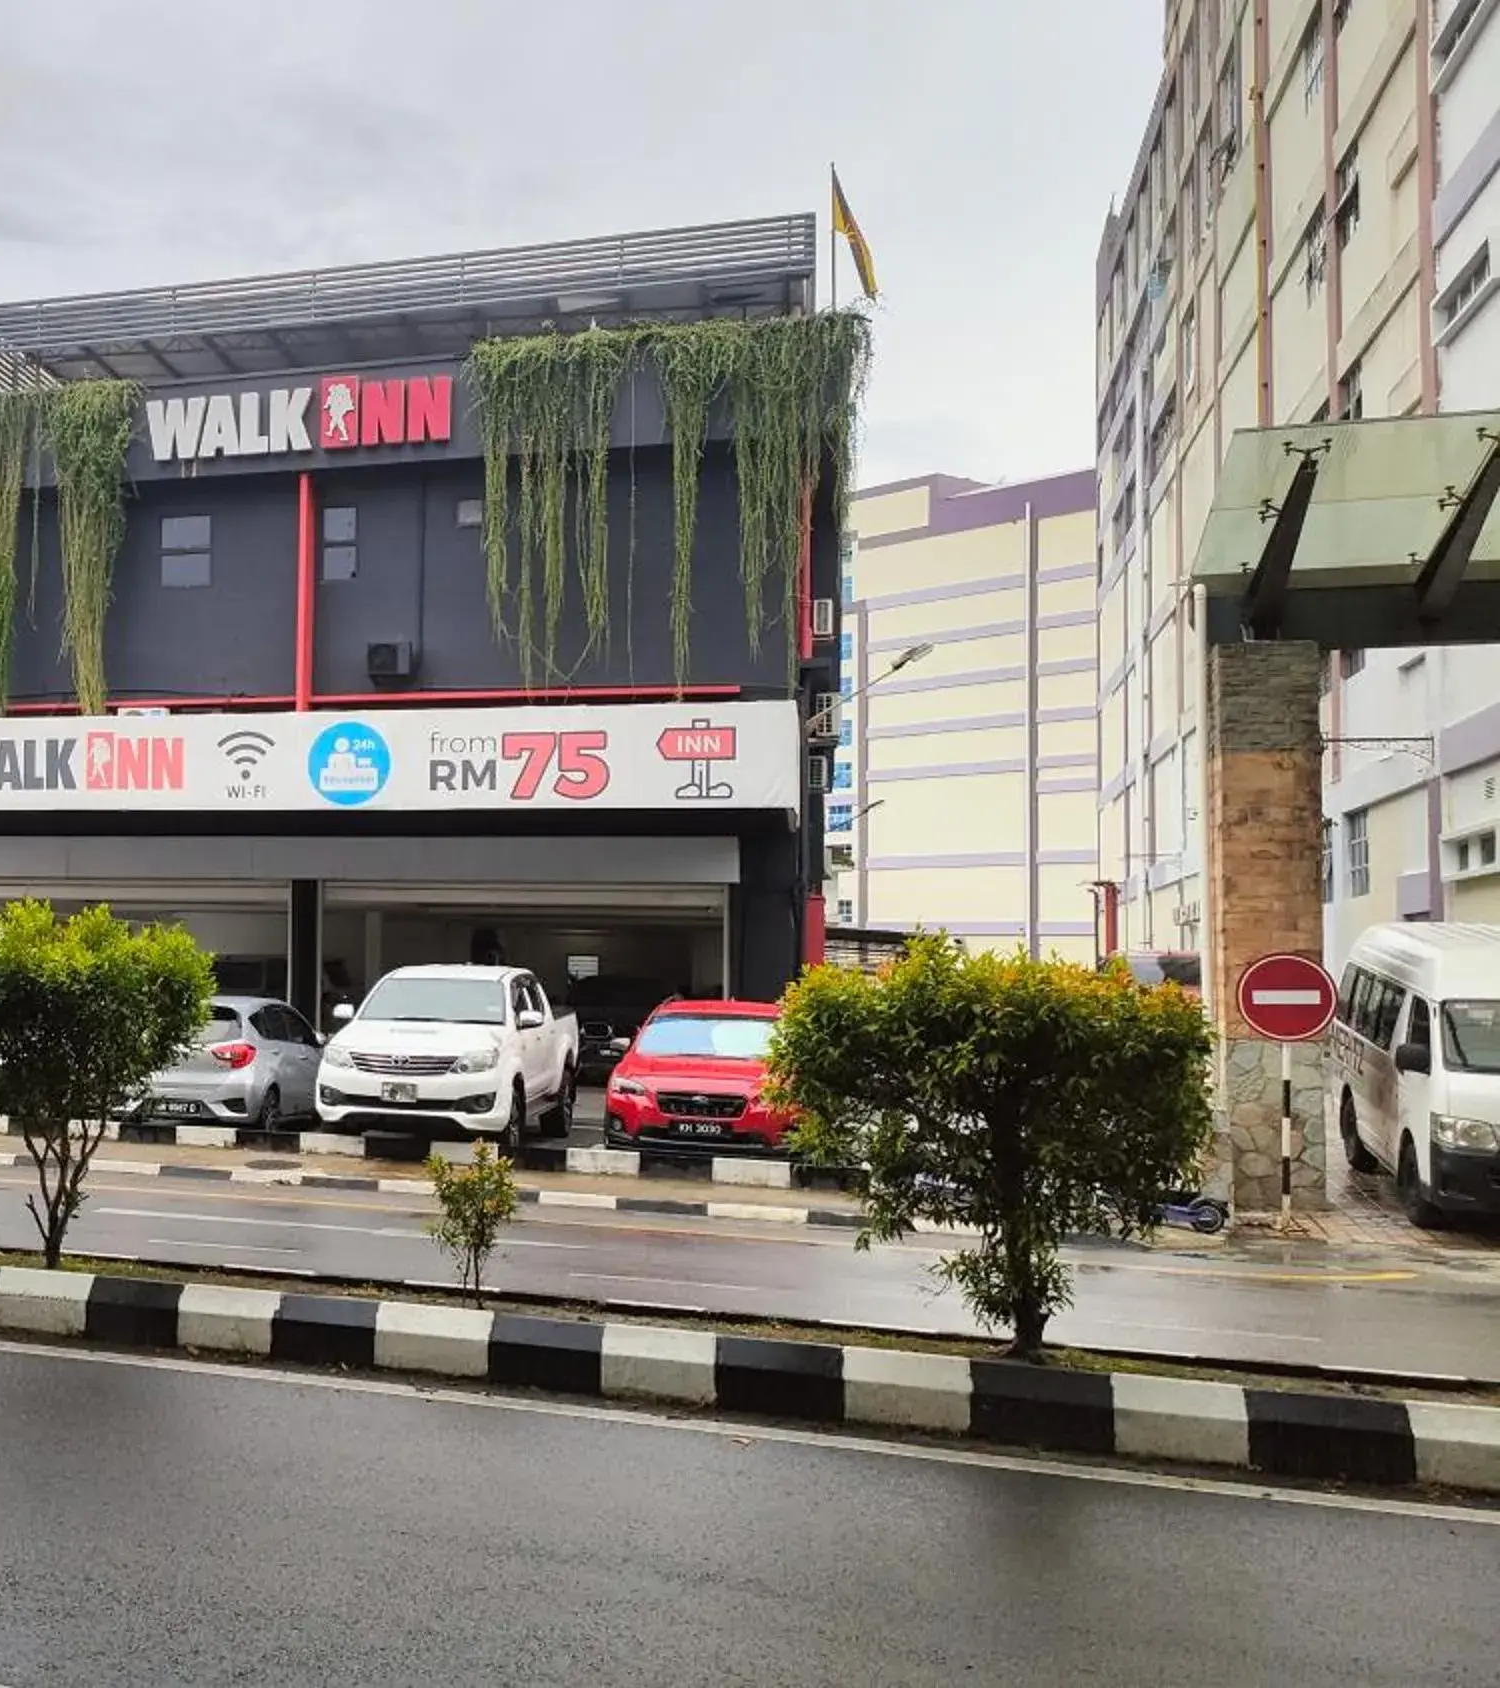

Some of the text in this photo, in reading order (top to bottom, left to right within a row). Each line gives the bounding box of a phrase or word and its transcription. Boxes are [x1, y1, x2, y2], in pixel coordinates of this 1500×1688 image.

[146, 387, 313, 461] WALK
[352, 738, 376, 751] 24h
[430, 731, 497, 754] from
[677, 735, 721, 753] INN
[429, 730, 610, 800] RM 75
